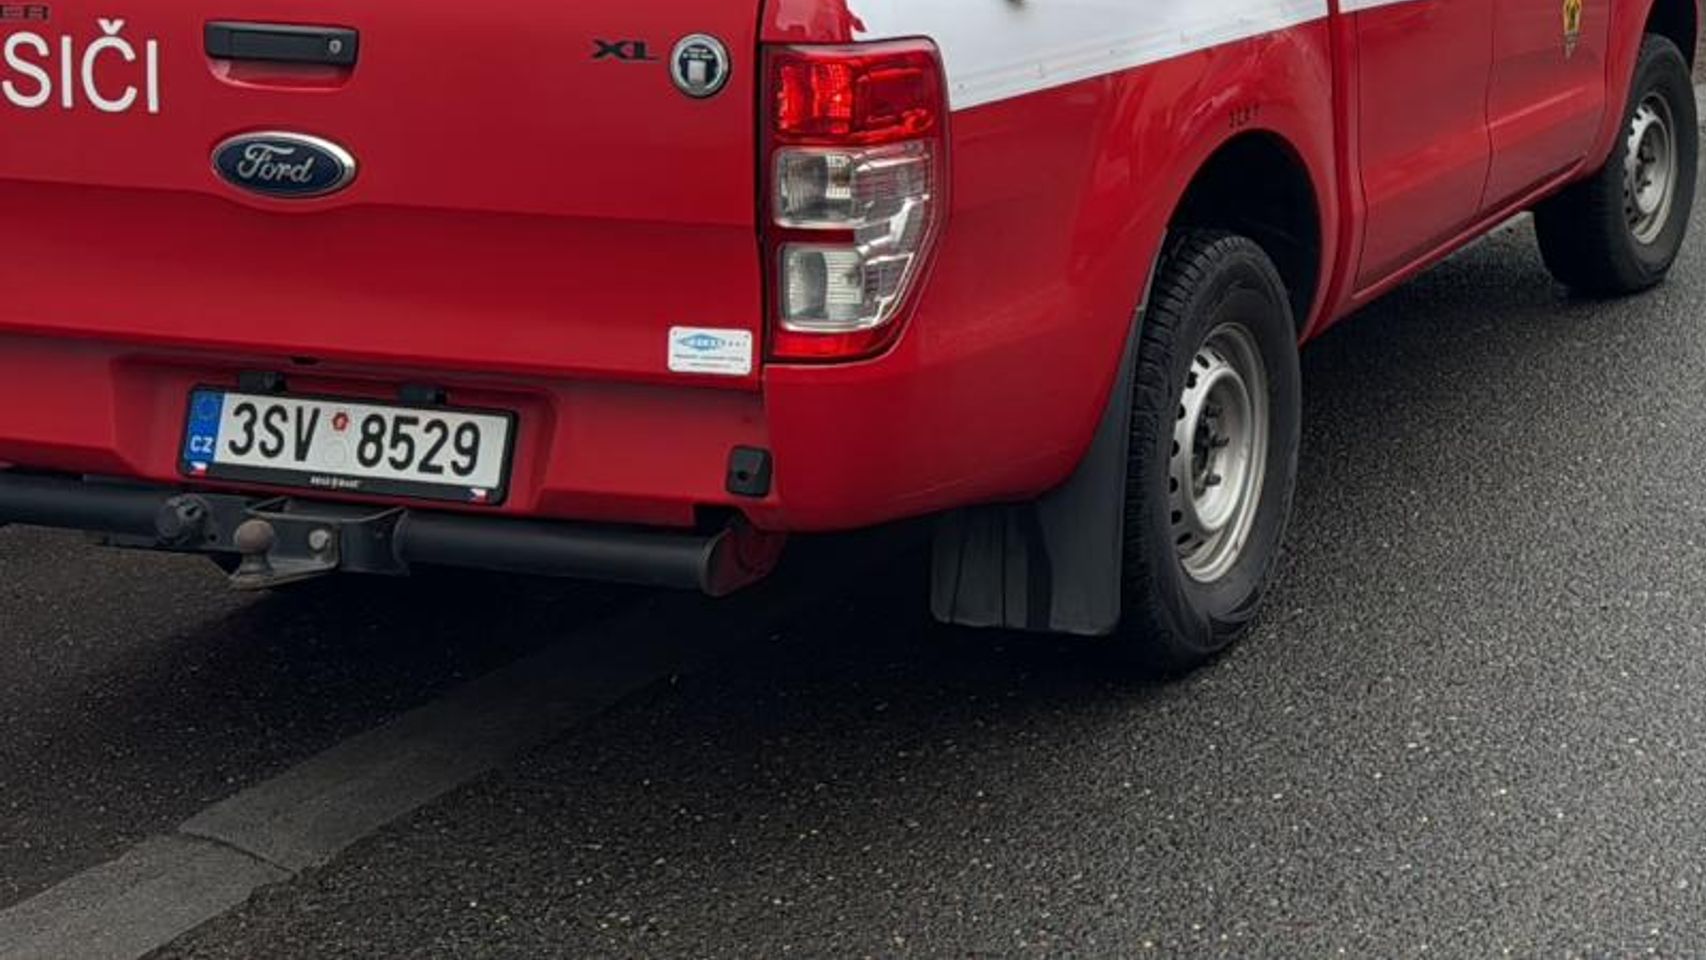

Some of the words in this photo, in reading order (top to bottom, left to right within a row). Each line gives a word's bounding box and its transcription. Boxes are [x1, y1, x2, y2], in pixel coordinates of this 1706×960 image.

[2, 18, 159, 113] SIČI
[592, 39, 660, 61] XL
[237, 143, 316, 183] Ford
[190, 436, 214, 453] CZ
[228, 403, 321, 462] 3SV
[356, 413, 481, 477] 8529
